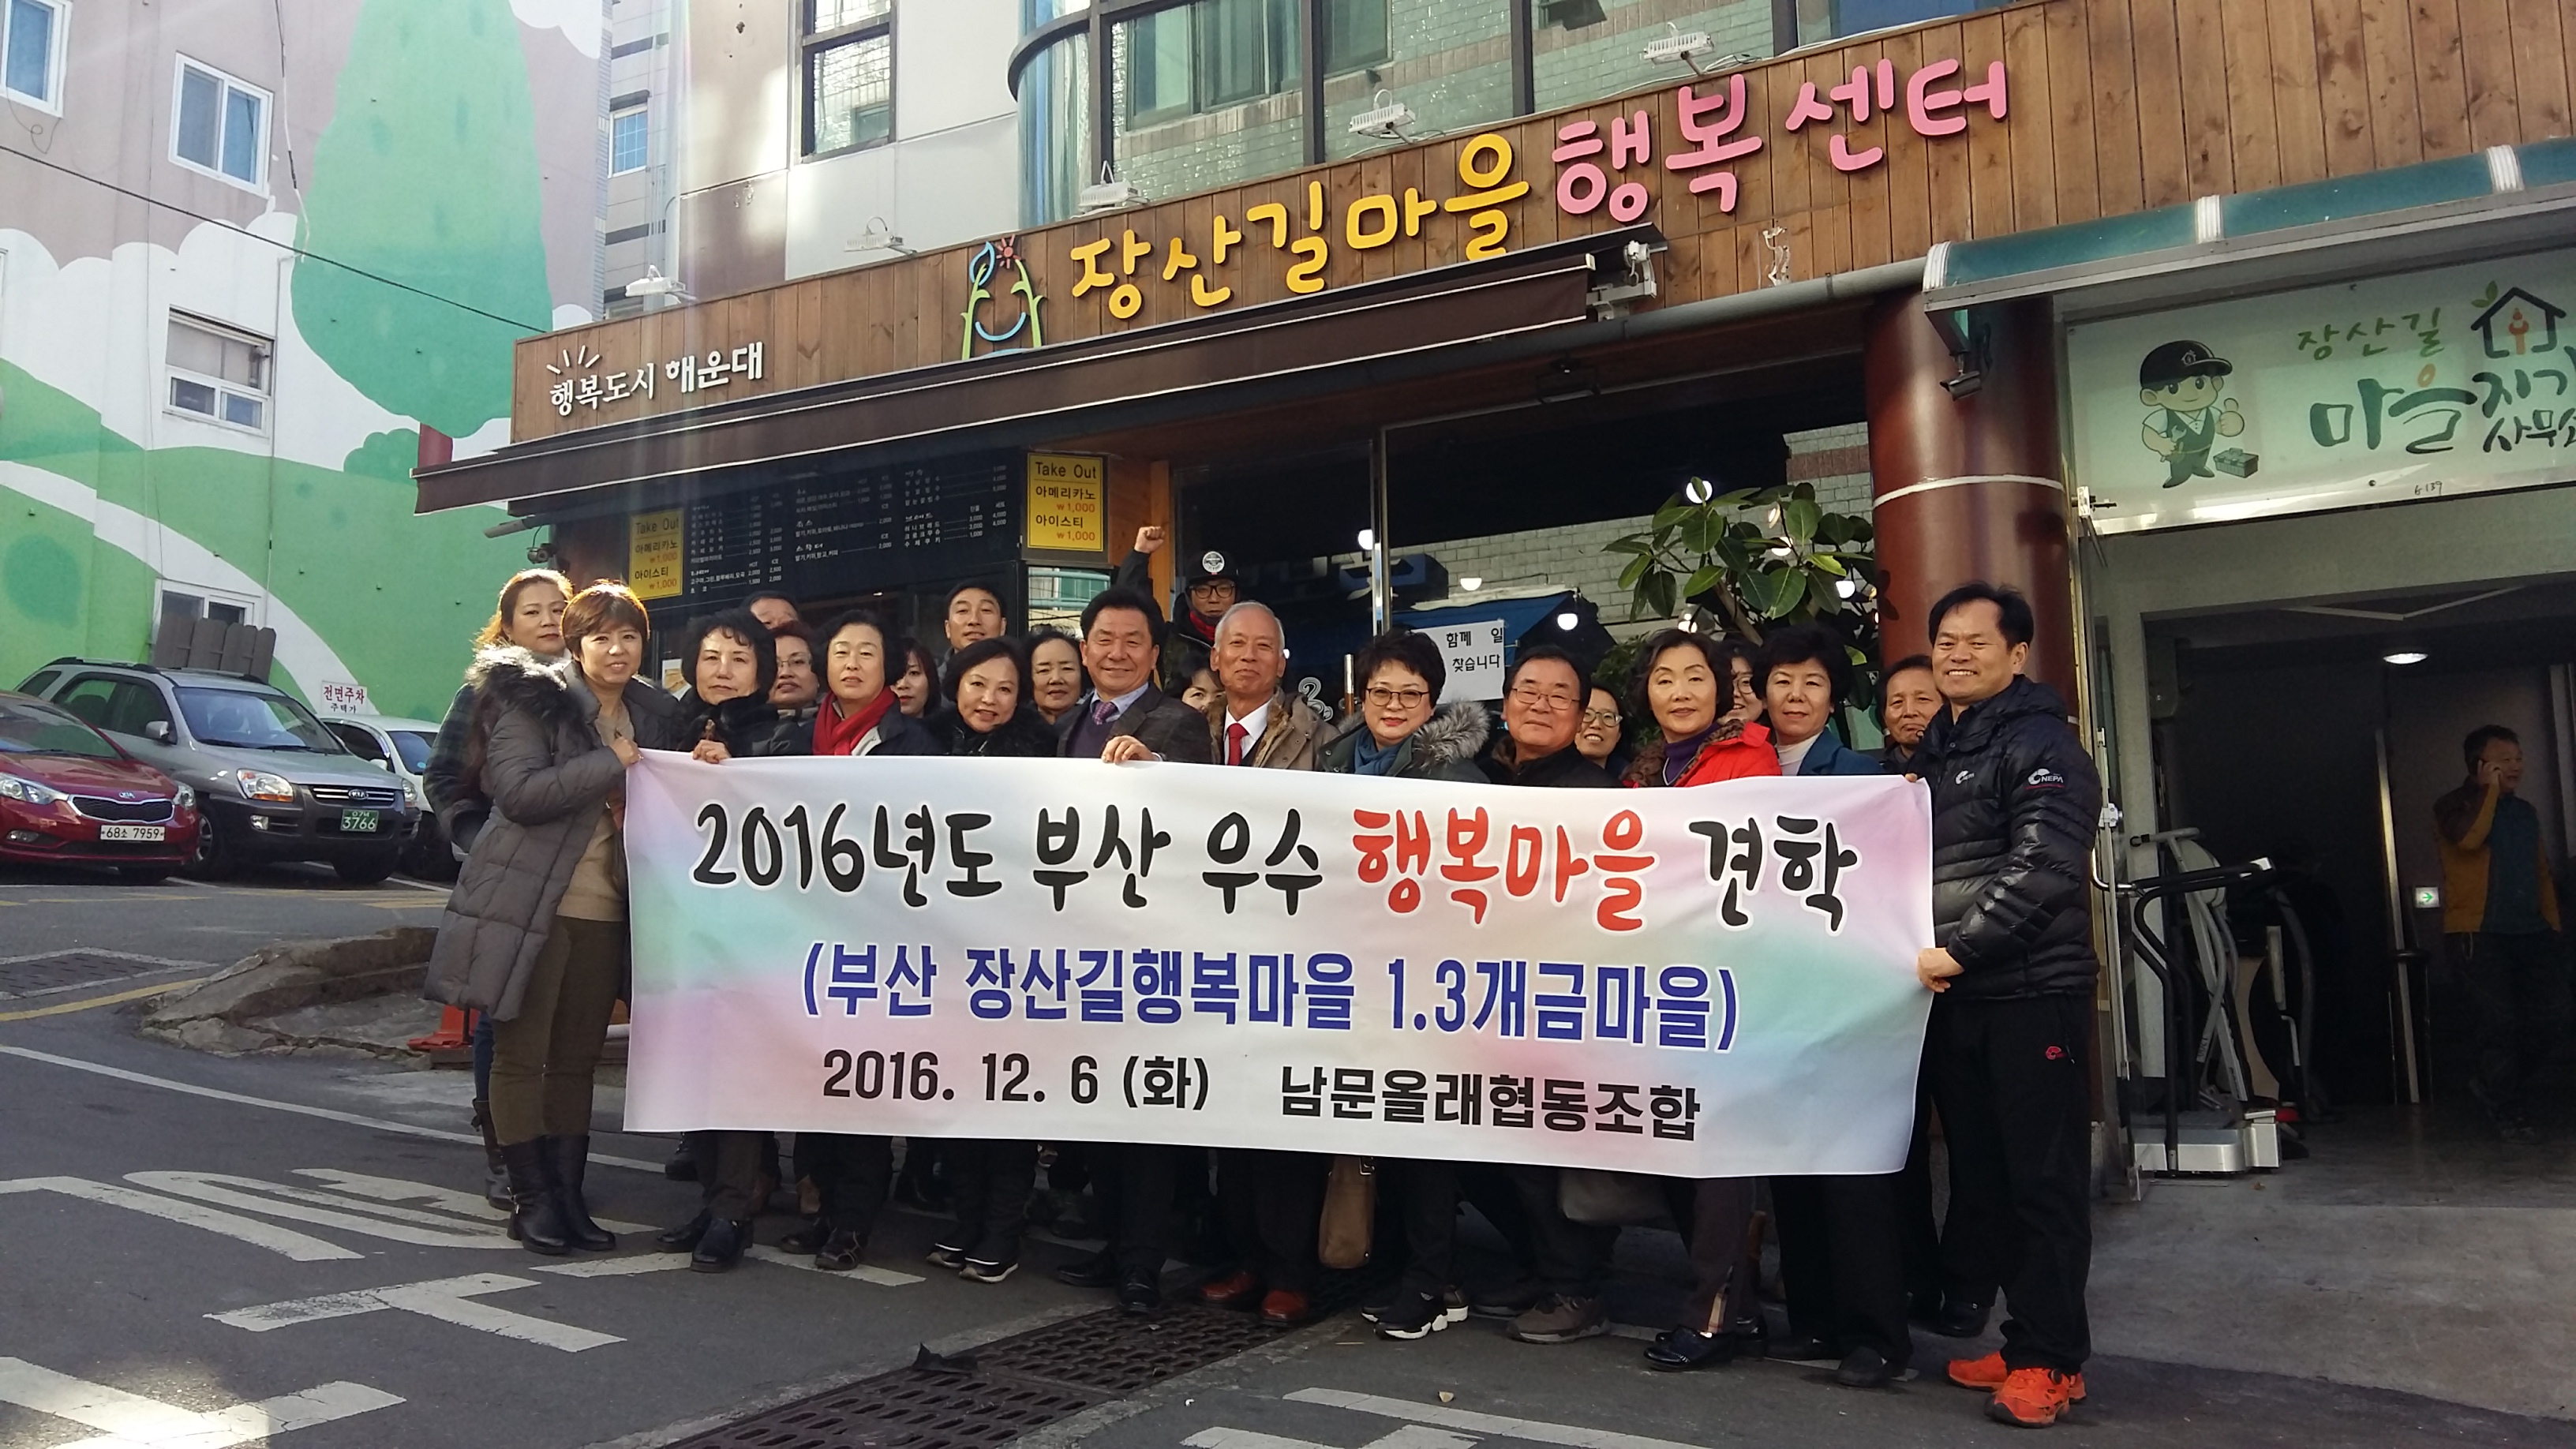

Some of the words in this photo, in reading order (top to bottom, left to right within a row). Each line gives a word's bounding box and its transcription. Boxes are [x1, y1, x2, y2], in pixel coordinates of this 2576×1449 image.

[2297, 306, 2446, 361] 장산길
[549, 361, 657, 417] 행복도시
[665, 341, 763, 393] 해운대
[1035, 462, 1066, 477] Take
[1073, 464, 1096, 479] Out
[1035, 485, 1096, 500] 아메리카노
[636, 522, 657, 534] Take
[663, 517, 679, 530] Out
[1035, 515, 1084, 528] 아이스티
[635, 540, 678, 554] 아메리카노
[635, 567, 668, 580] 아이스티
[1446, 631, 1471, 649] 함께
[1491, 627, 1503, 644] 일
[1452, 654, 1500, 672] 찾습니다
[324, 684, 365, 705] 전면주차
[343, 817, 376, 829] 3766
[107, 827, 128, 838] 68소
[133, 828, 159, 839] 7959
[692, 803, 1002, 907] 2016년도
[1032, 803, 1172, 913] 부산
[1202, 807, 1324, 915] 우수
[1353, 807, 1655, 931] 행복마을
[1688, 814, 1858, 933] 견학
[803, 942, 938, 1017] (부산
[965, 948, 1355, 1030] 장산길행복마을
[1387, 957, 1738, 1051] 1.3개금마을)
[823, 1049, 955, 1100] 2016.
[982, 1053, 1045, 1103] 12.
[1071, 1056, 1098, 1104] 6
[1122, 1054, 1210, 1110] (화)
[1281, 1065, 1701, 1141] 남문올래협동조합
